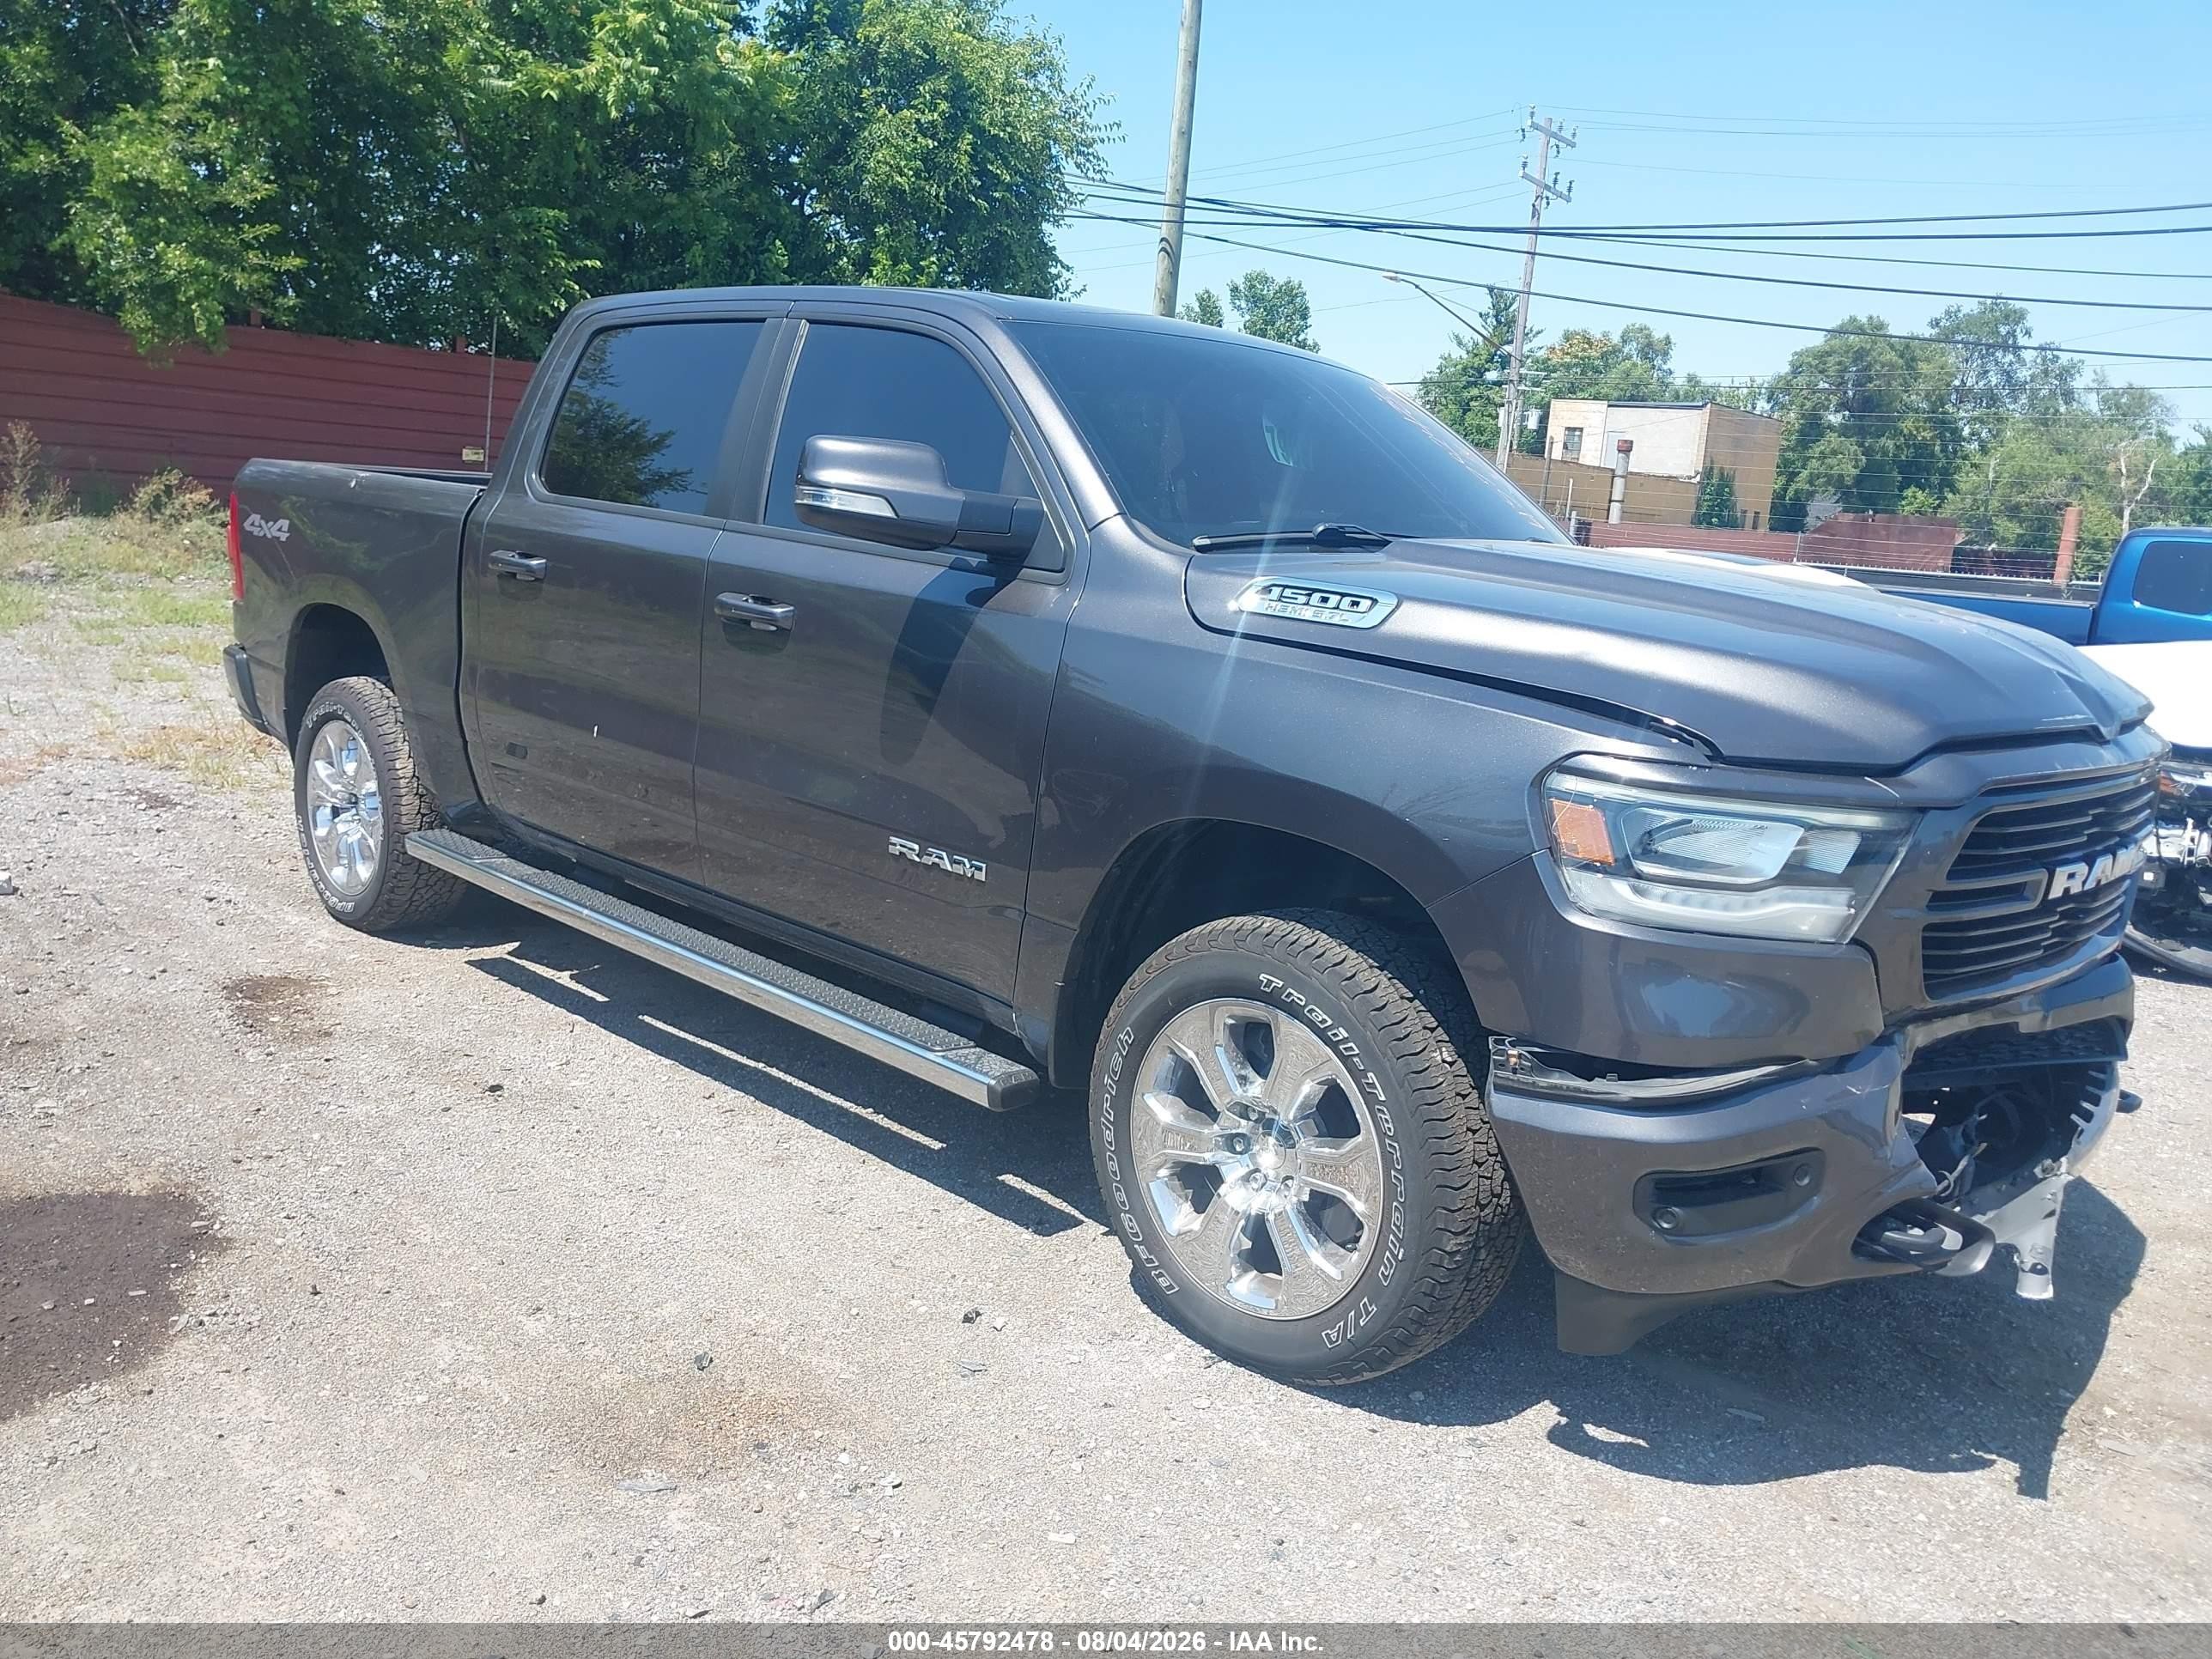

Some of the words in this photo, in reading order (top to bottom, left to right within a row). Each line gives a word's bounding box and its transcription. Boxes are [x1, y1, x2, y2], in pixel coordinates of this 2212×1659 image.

[1267, 586, 1373, 613] 1500
[888, 836, 987, 882] RAM
[2047, 843, 2145, 900] RAM
[1258, 973, 1405, 1286] Trail-Terrain
[1100, 1026, 1180, 1294] BFGoodrich
[1322, 1296, 1377, 1348] T/A
